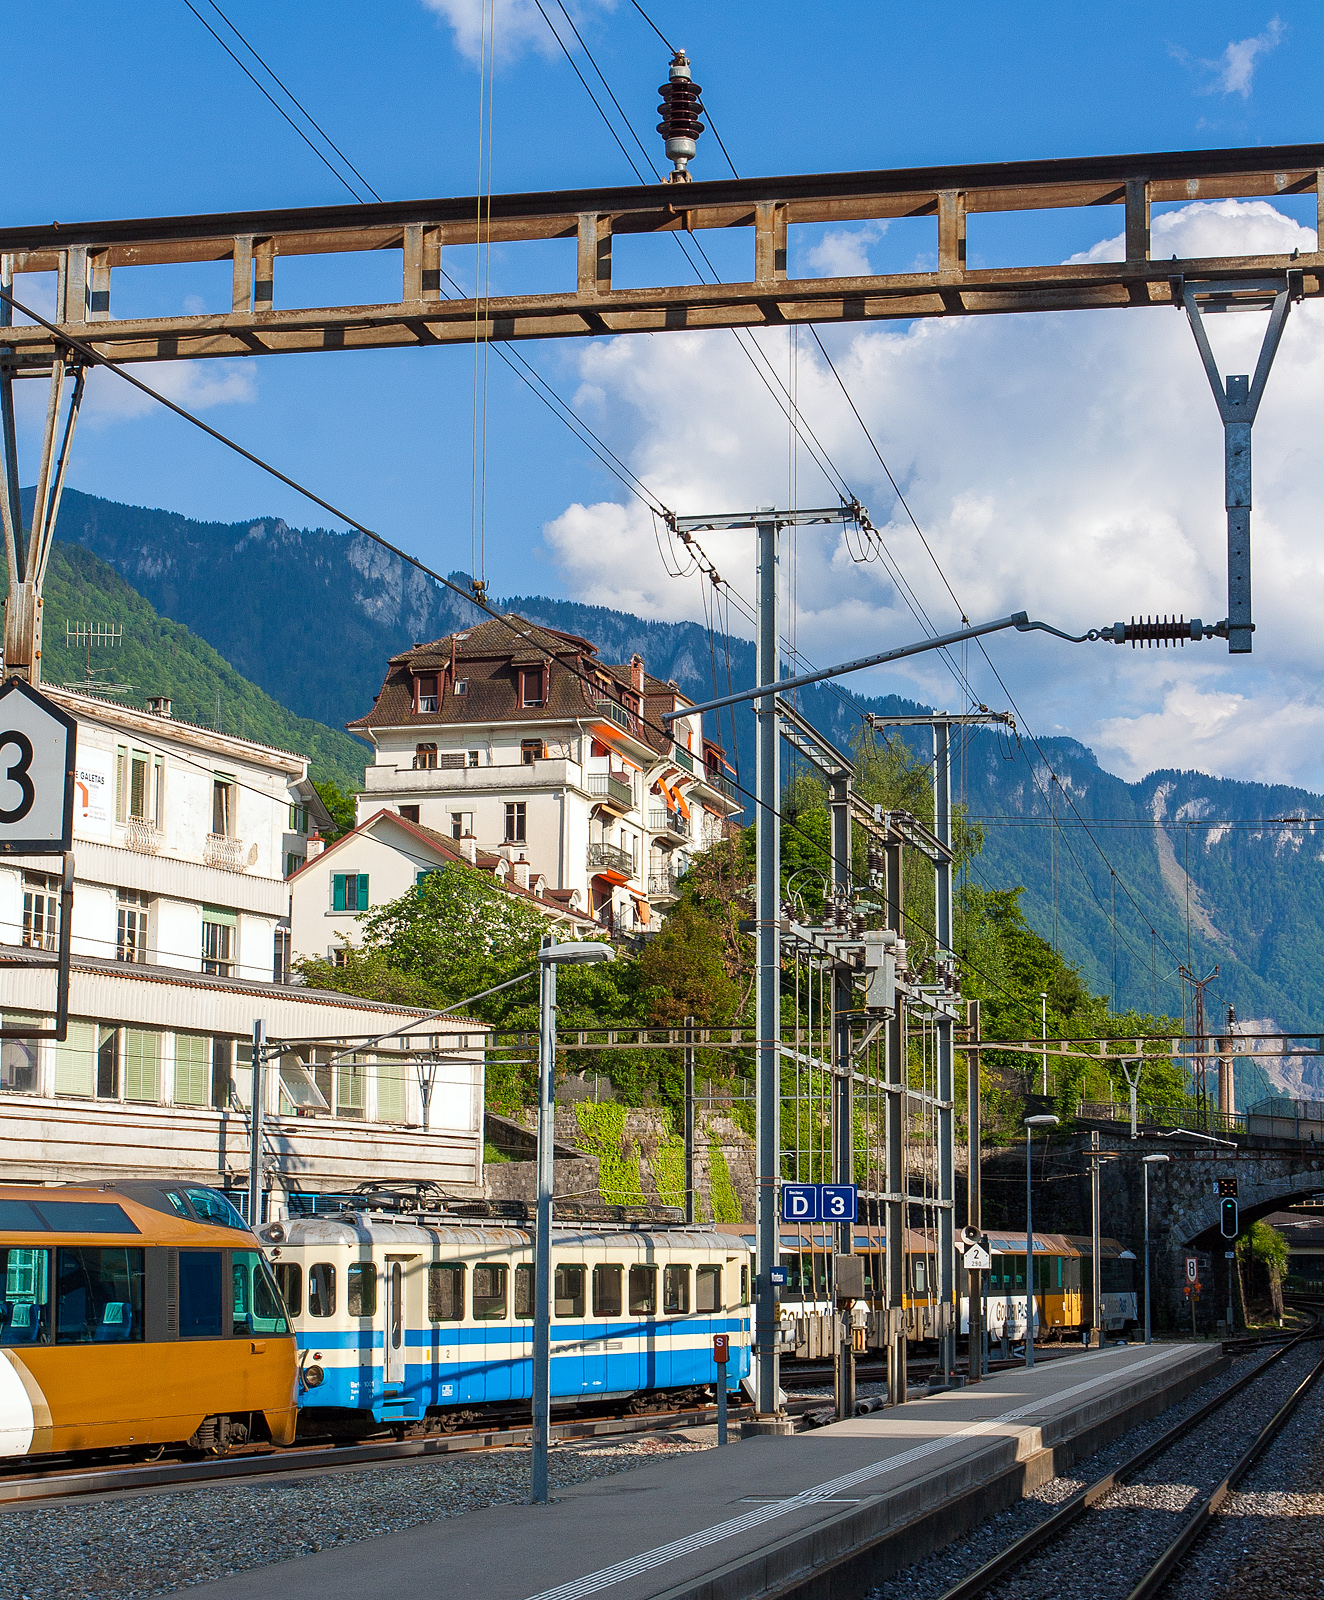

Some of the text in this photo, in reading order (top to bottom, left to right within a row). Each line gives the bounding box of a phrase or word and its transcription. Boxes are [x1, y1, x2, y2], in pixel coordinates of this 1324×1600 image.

[0, 730, 35, 824] 3
[80, 771, 105, 785] GALETAS
[792, 1196, 809, 1216] D
[830, 1196, 845, 1216] 3
[973, 1249, 980, 1260] 2
[1188, 1261, 1195, 1277] 8
[716, 1337, 724, 1347] S
[445, 1349, 450, 1359] 2
